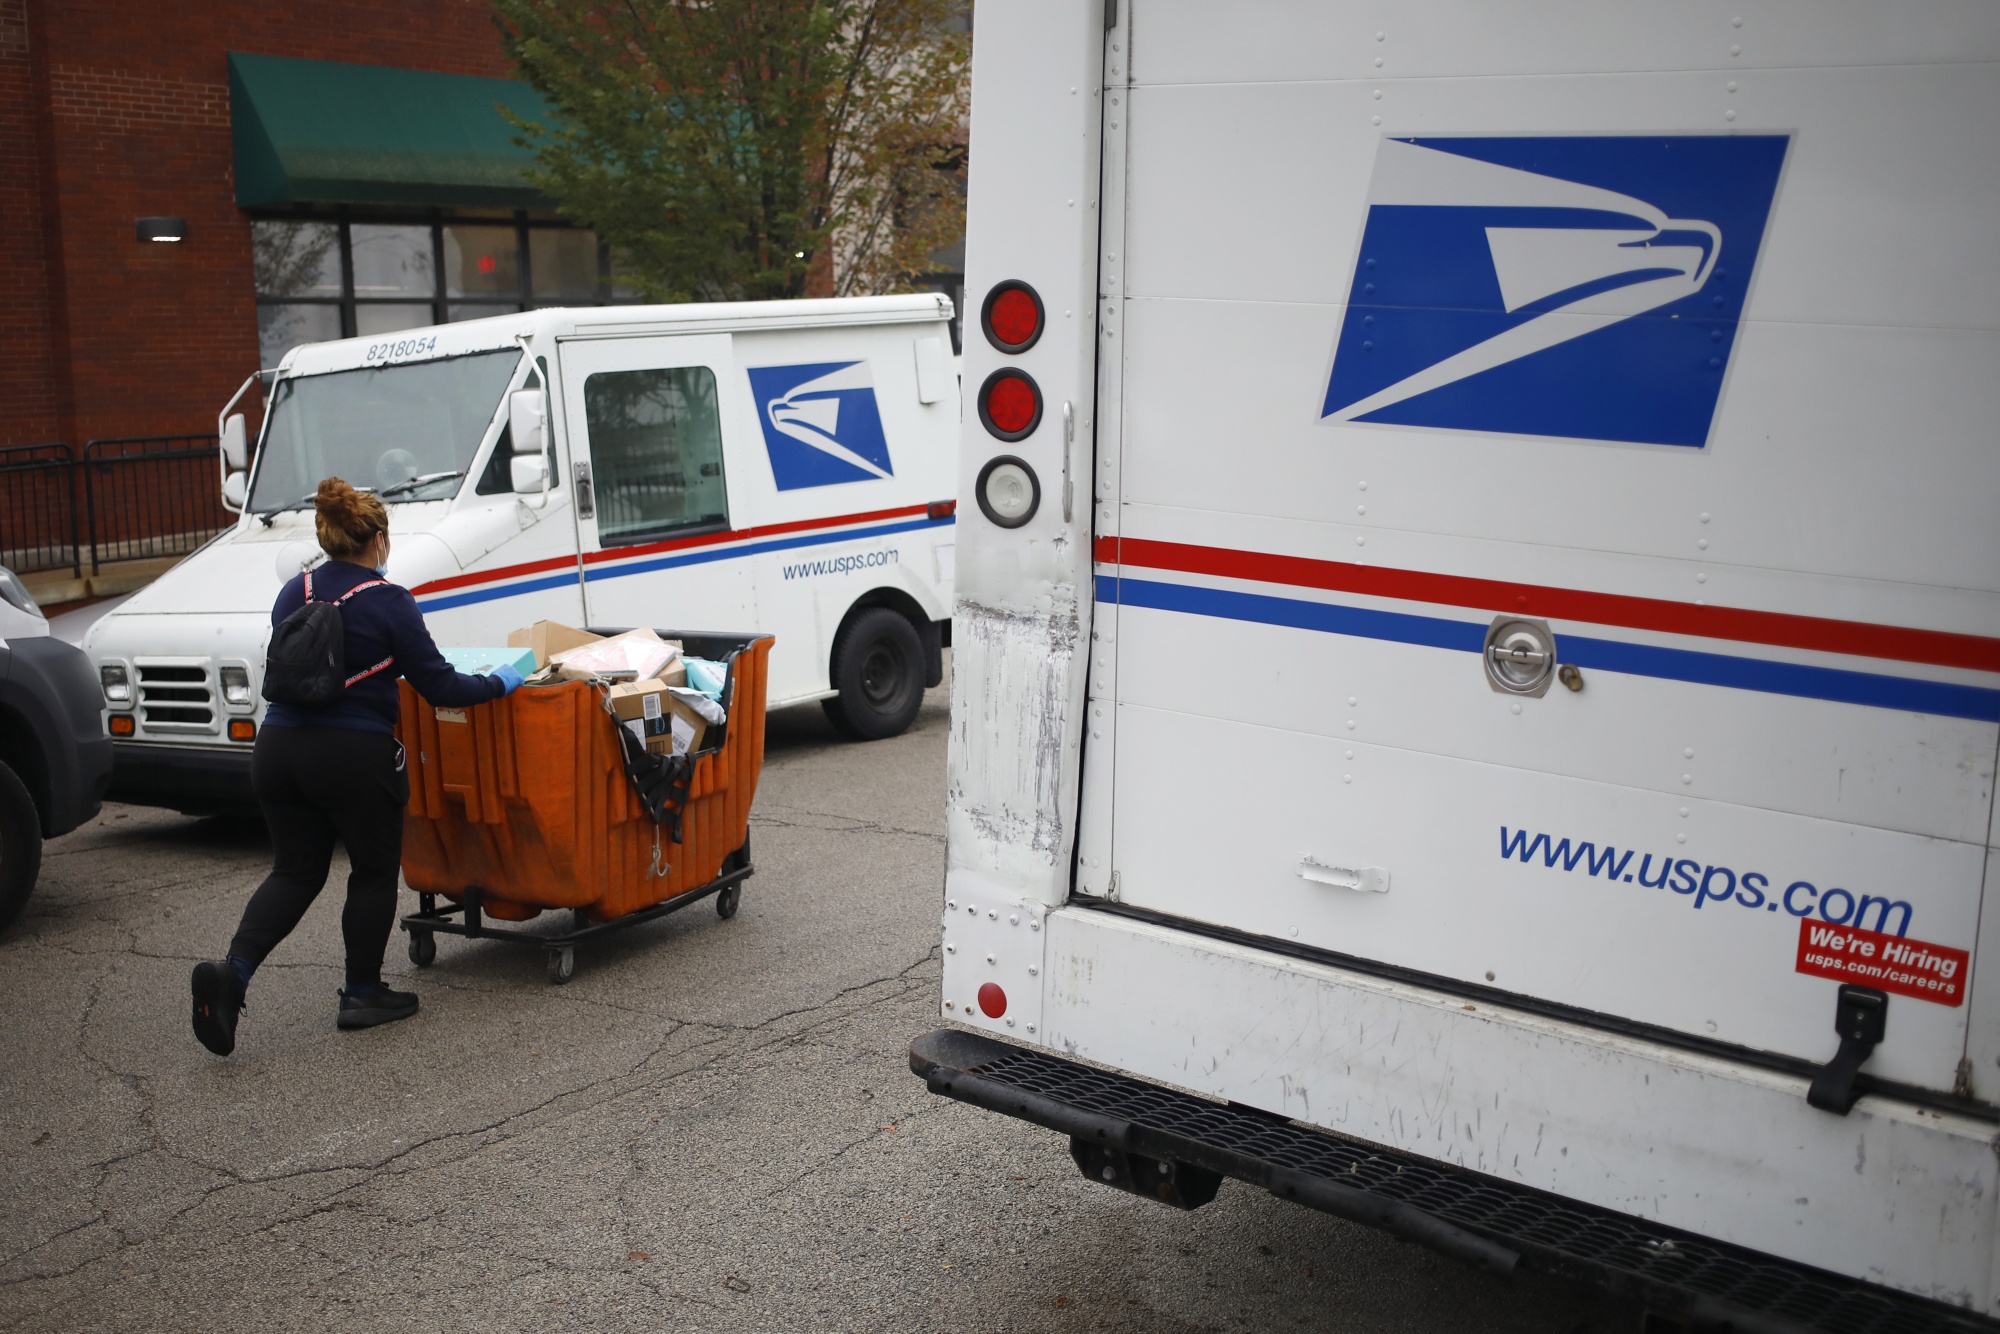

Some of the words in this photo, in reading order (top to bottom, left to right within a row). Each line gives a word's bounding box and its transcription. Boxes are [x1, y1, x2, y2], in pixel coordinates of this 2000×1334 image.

[367, 336, 437, 361] 8218054
[783, 549, 899, 580] www.usps.com
[1499, 826, 1914, 938] www.usps.com
[1809, 926, 1876, 957] We're
[1881, 941, 1959, 979] Hiring
[1804, 953, 1956, 994] usps.com/careers
